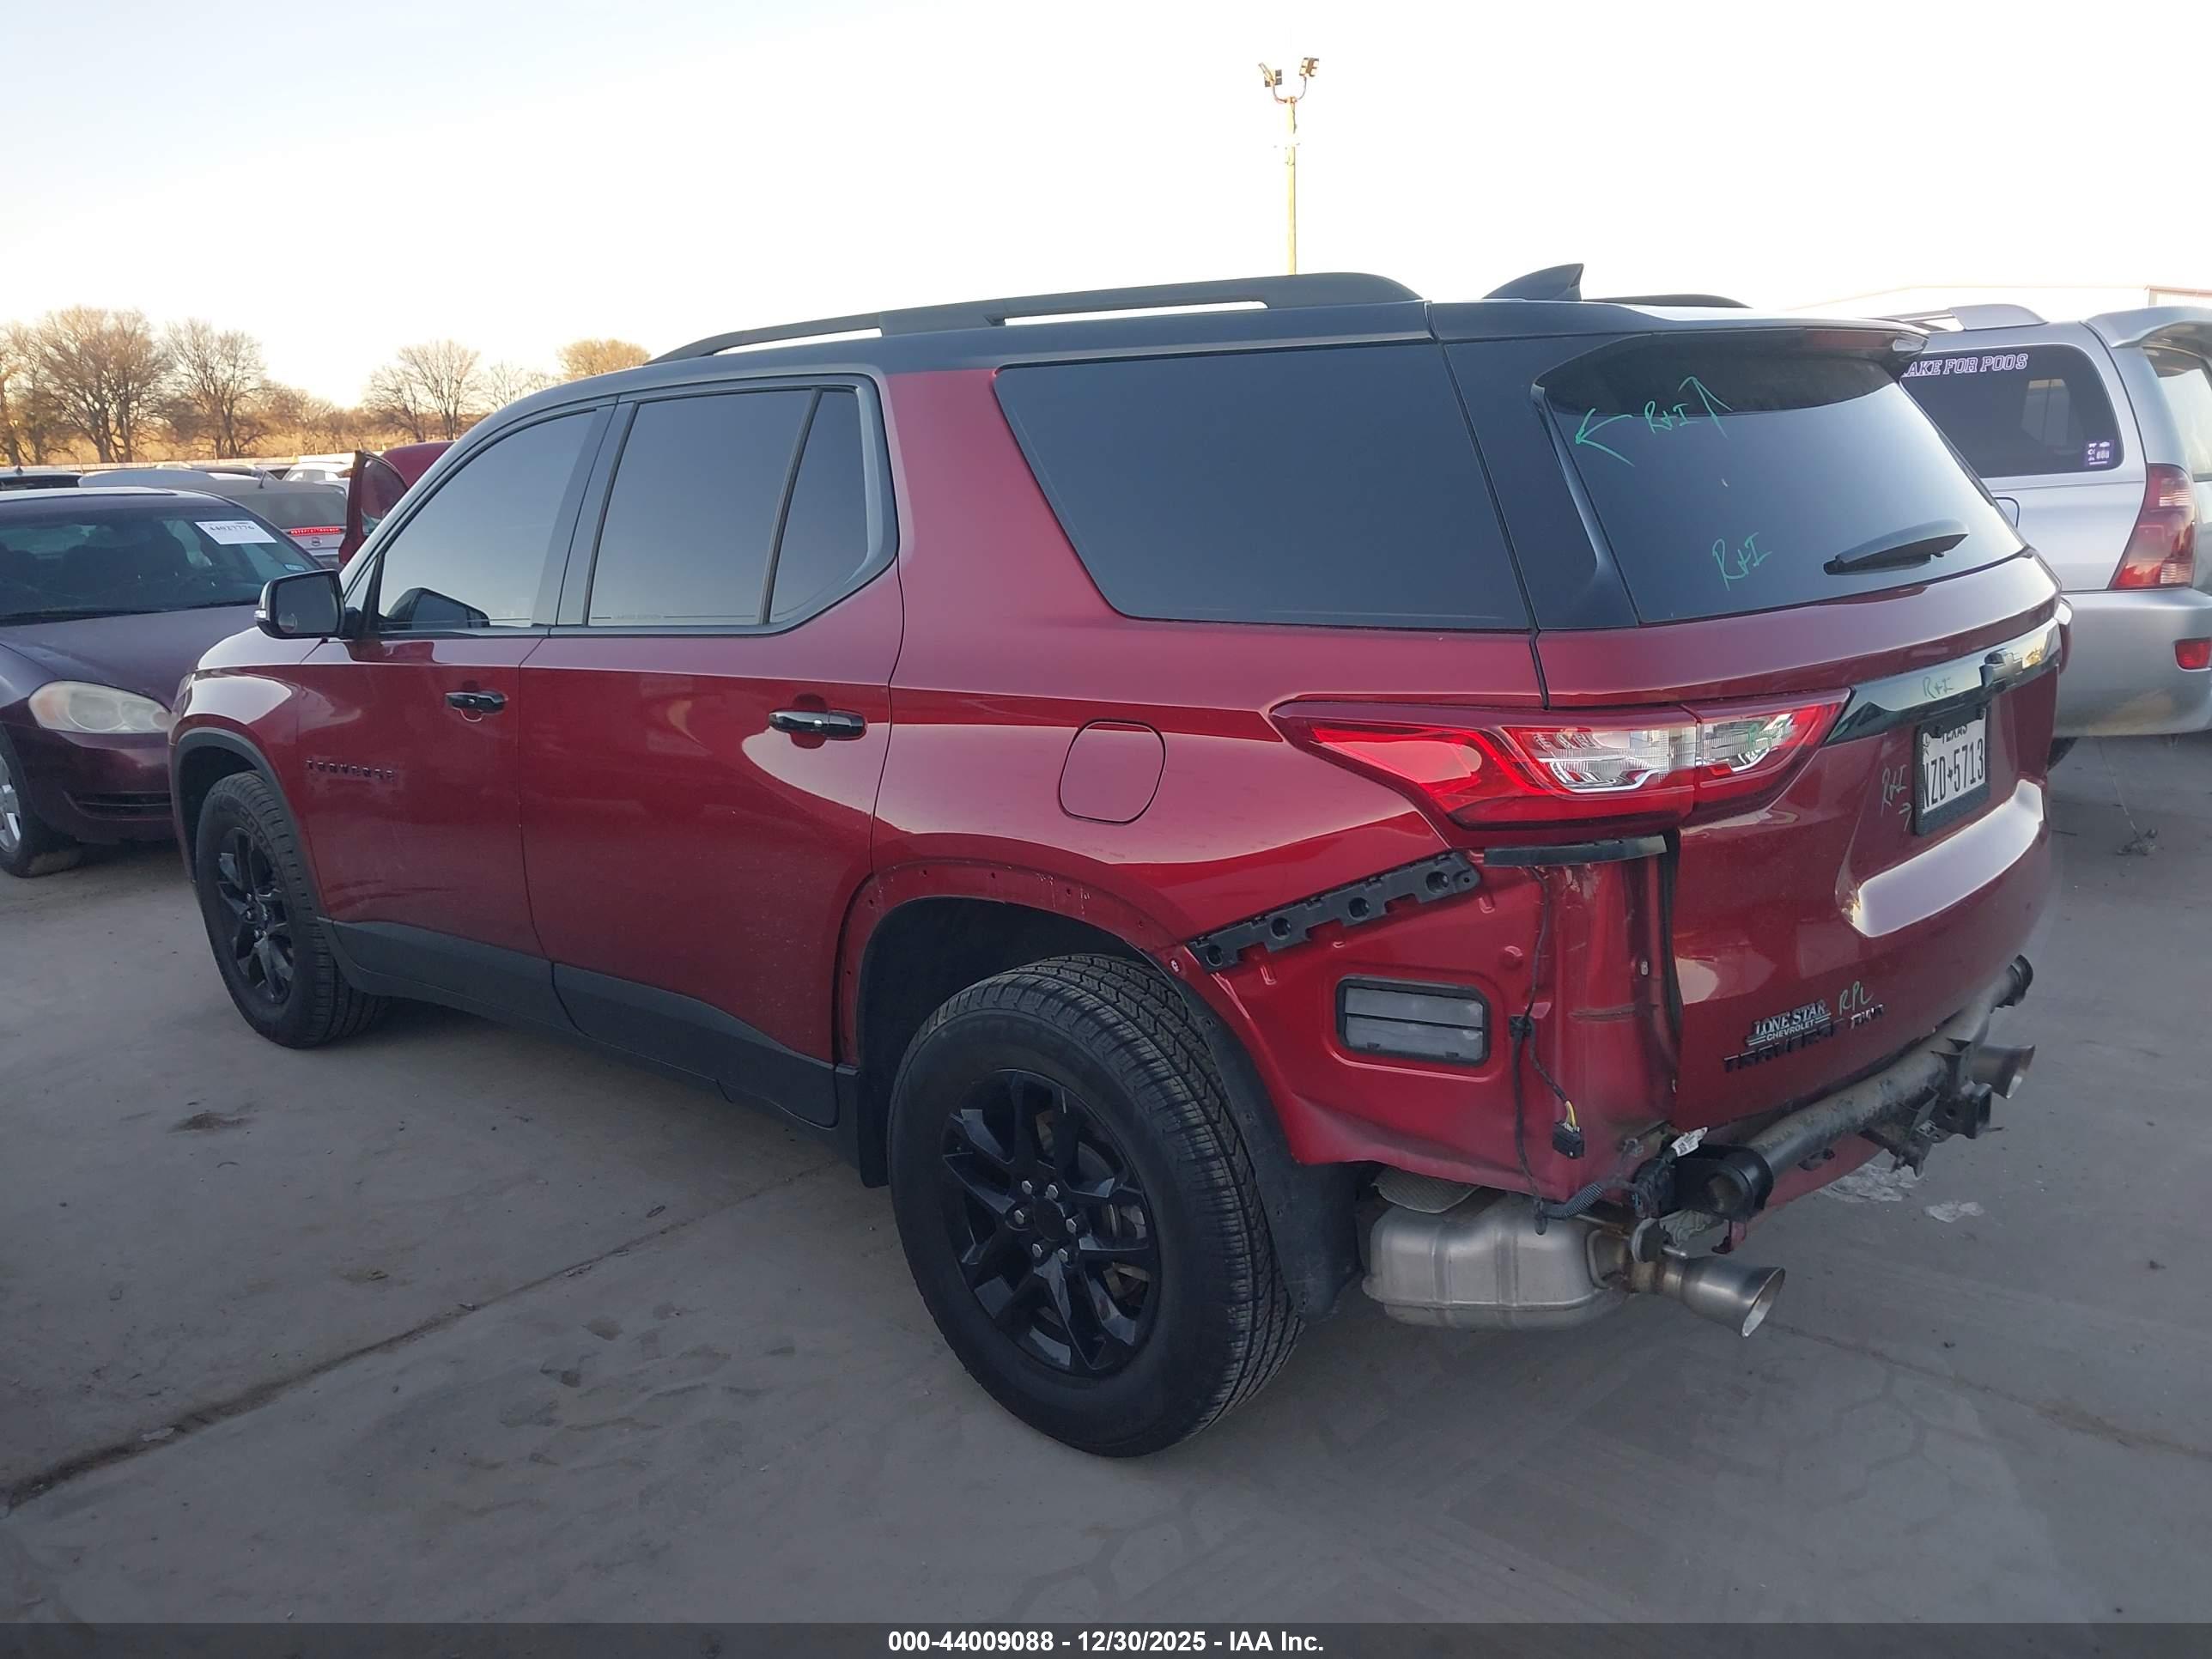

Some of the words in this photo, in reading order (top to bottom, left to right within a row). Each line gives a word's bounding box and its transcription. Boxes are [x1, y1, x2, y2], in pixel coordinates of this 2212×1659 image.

[1943, 356, 1978, 375] FOR
[1979, 353, 2028, 373] POOS
[1838, 981, 1875, 1015] RPL
[1753, 1012, 1792, 1036] LONE
[1791, 1000, 1829, 1026] STAR
[1766, 1020, 1816, 1042] CHEVROLET
